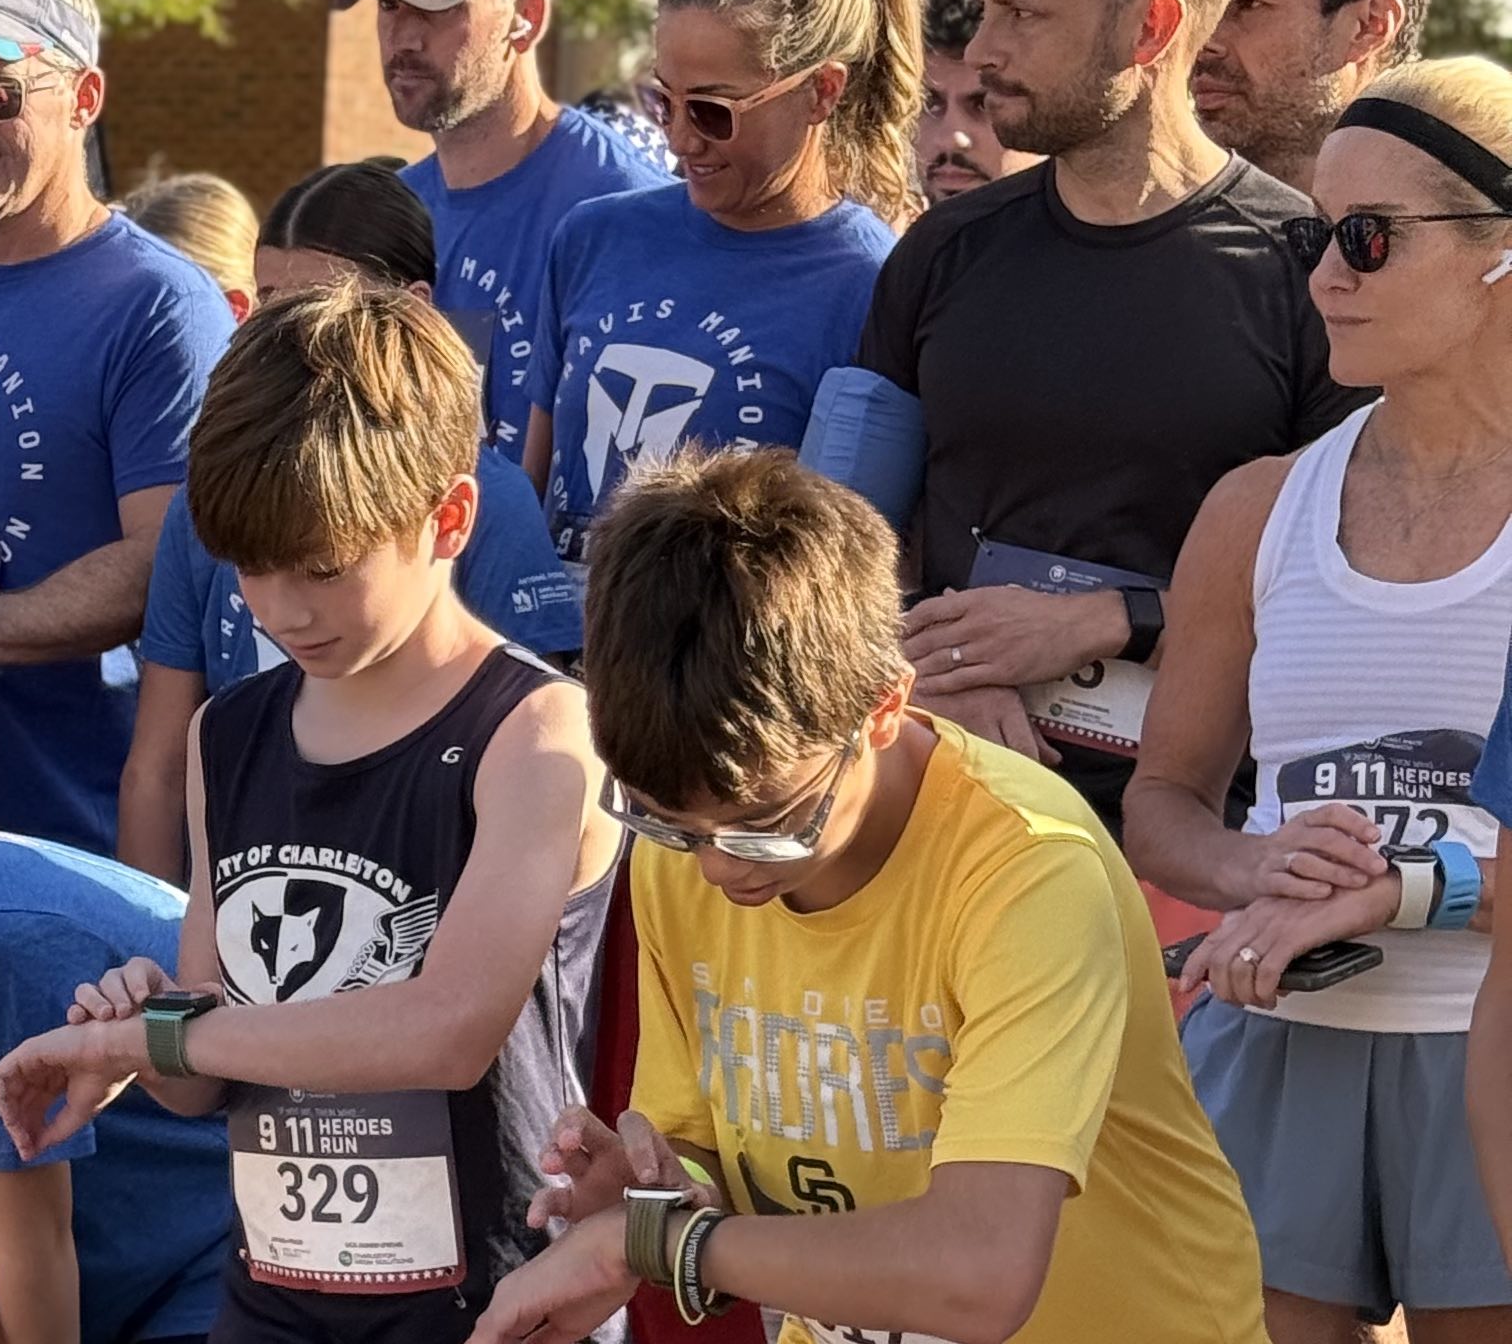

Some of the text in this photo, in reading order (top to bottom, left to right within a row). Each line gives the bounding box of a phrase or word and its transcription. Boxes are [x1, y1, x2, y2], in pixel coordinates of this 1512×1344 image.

[555, 299, 675, 405] RAVIS
[1314, 762, 1472, 796] 9 11 HEROES
[1393, 784, 1433, 799] RUN
[1346, 805, 1449, 848] 72
[247, 844, 273, 866] OF
[803, 991, 944, 1029] DIEO
[259, 1114, 393, 1154] 9 11 HEROES
[320, 1137, 358, 1154] RUN
[277, 1161, 379, 1224] 329
